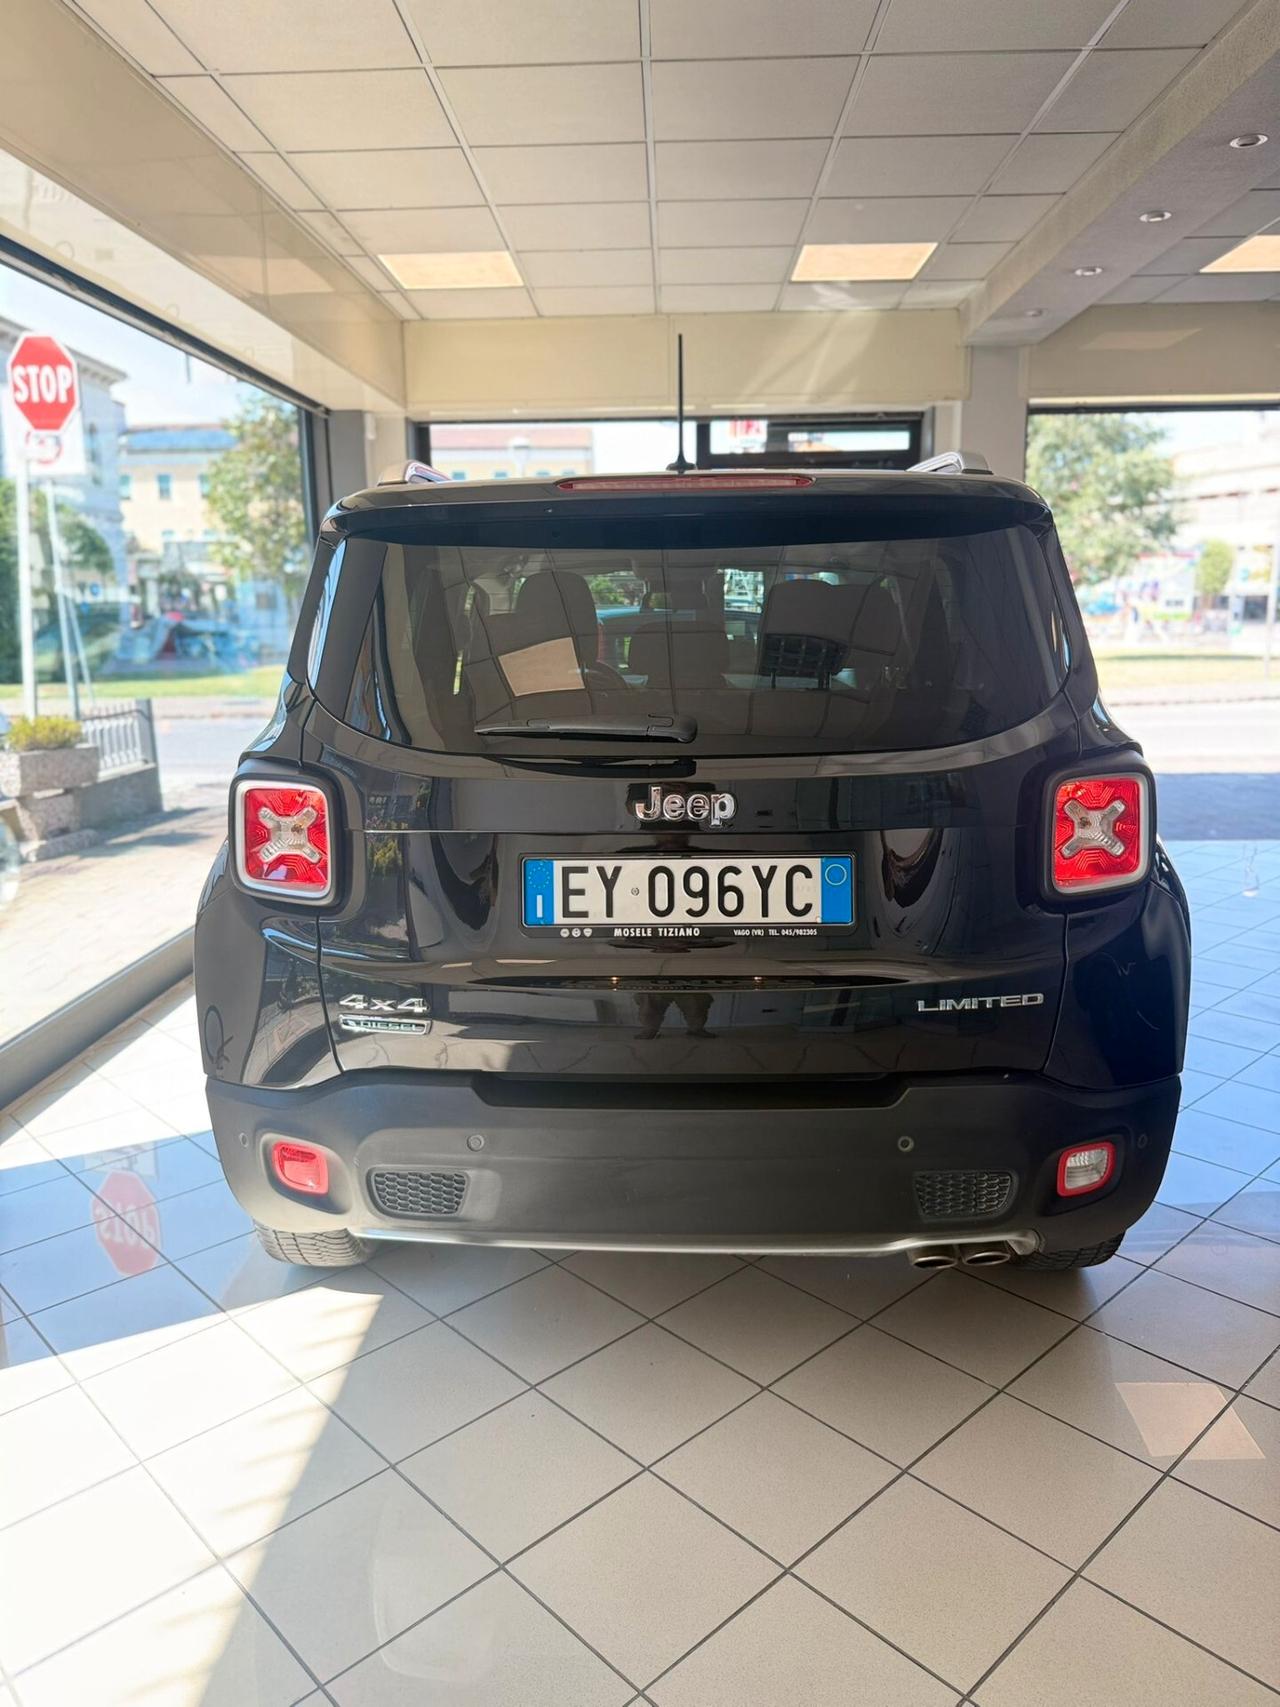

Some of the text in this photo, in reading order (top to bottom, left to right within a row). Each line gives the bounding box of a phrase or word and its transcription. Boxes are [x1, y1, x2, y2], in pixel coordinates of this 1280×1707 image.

[12, 364, 73, 404] STOP
[635, 786, 736, 826] Jeep
[561, 864, 813, 918] EY 096YC
[614, 928, 700, 936] MOSELE TIZIANO
[917, 993, 1044, 1012] LIMITED
[361, 1021, 423, 1031] DIESEL
